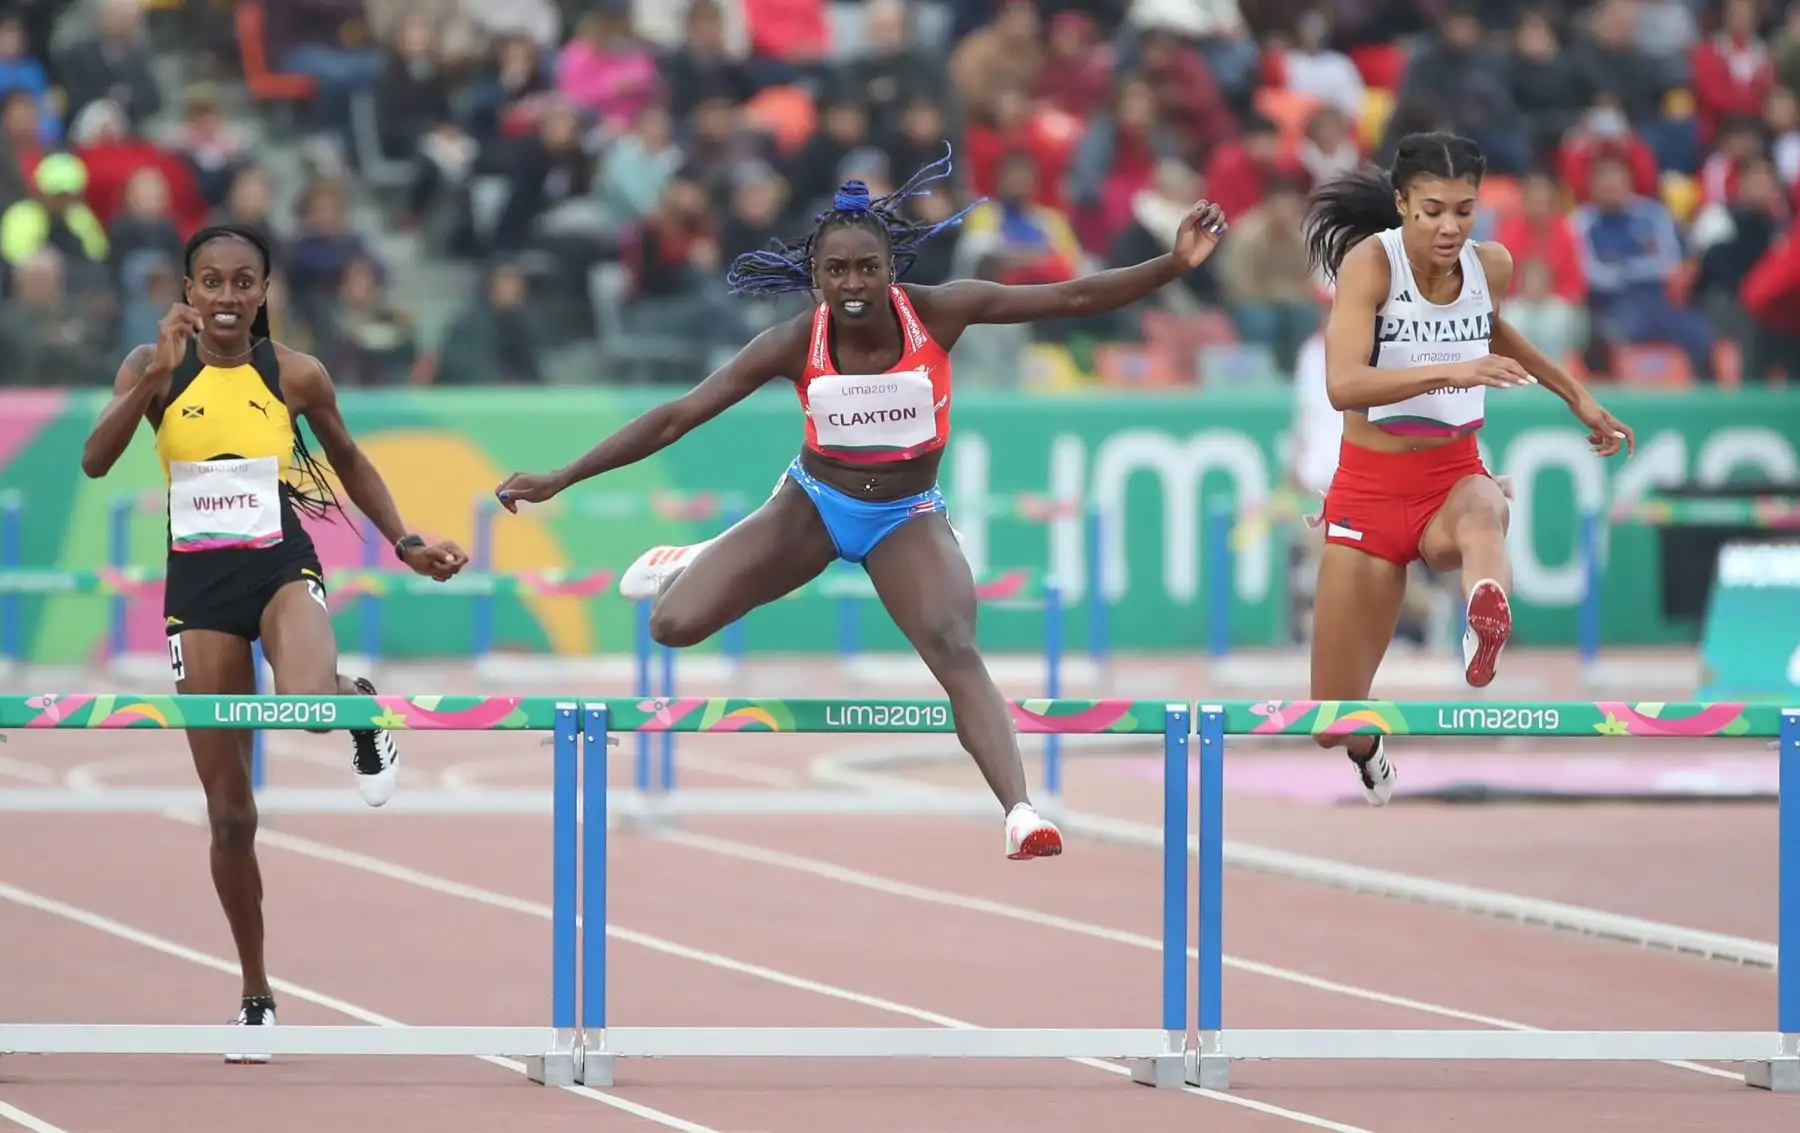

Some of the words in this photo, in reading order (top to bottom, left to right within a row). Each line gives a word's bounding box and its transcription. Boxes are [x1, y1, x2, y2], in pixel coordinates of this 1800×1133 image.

[1379, 314, 1490, 342] PANAMA
[828, 407, 917, 427] CLAXTON
[193, 494, 258, 511] WHYTE
[168, 639, 183, 677] 4
